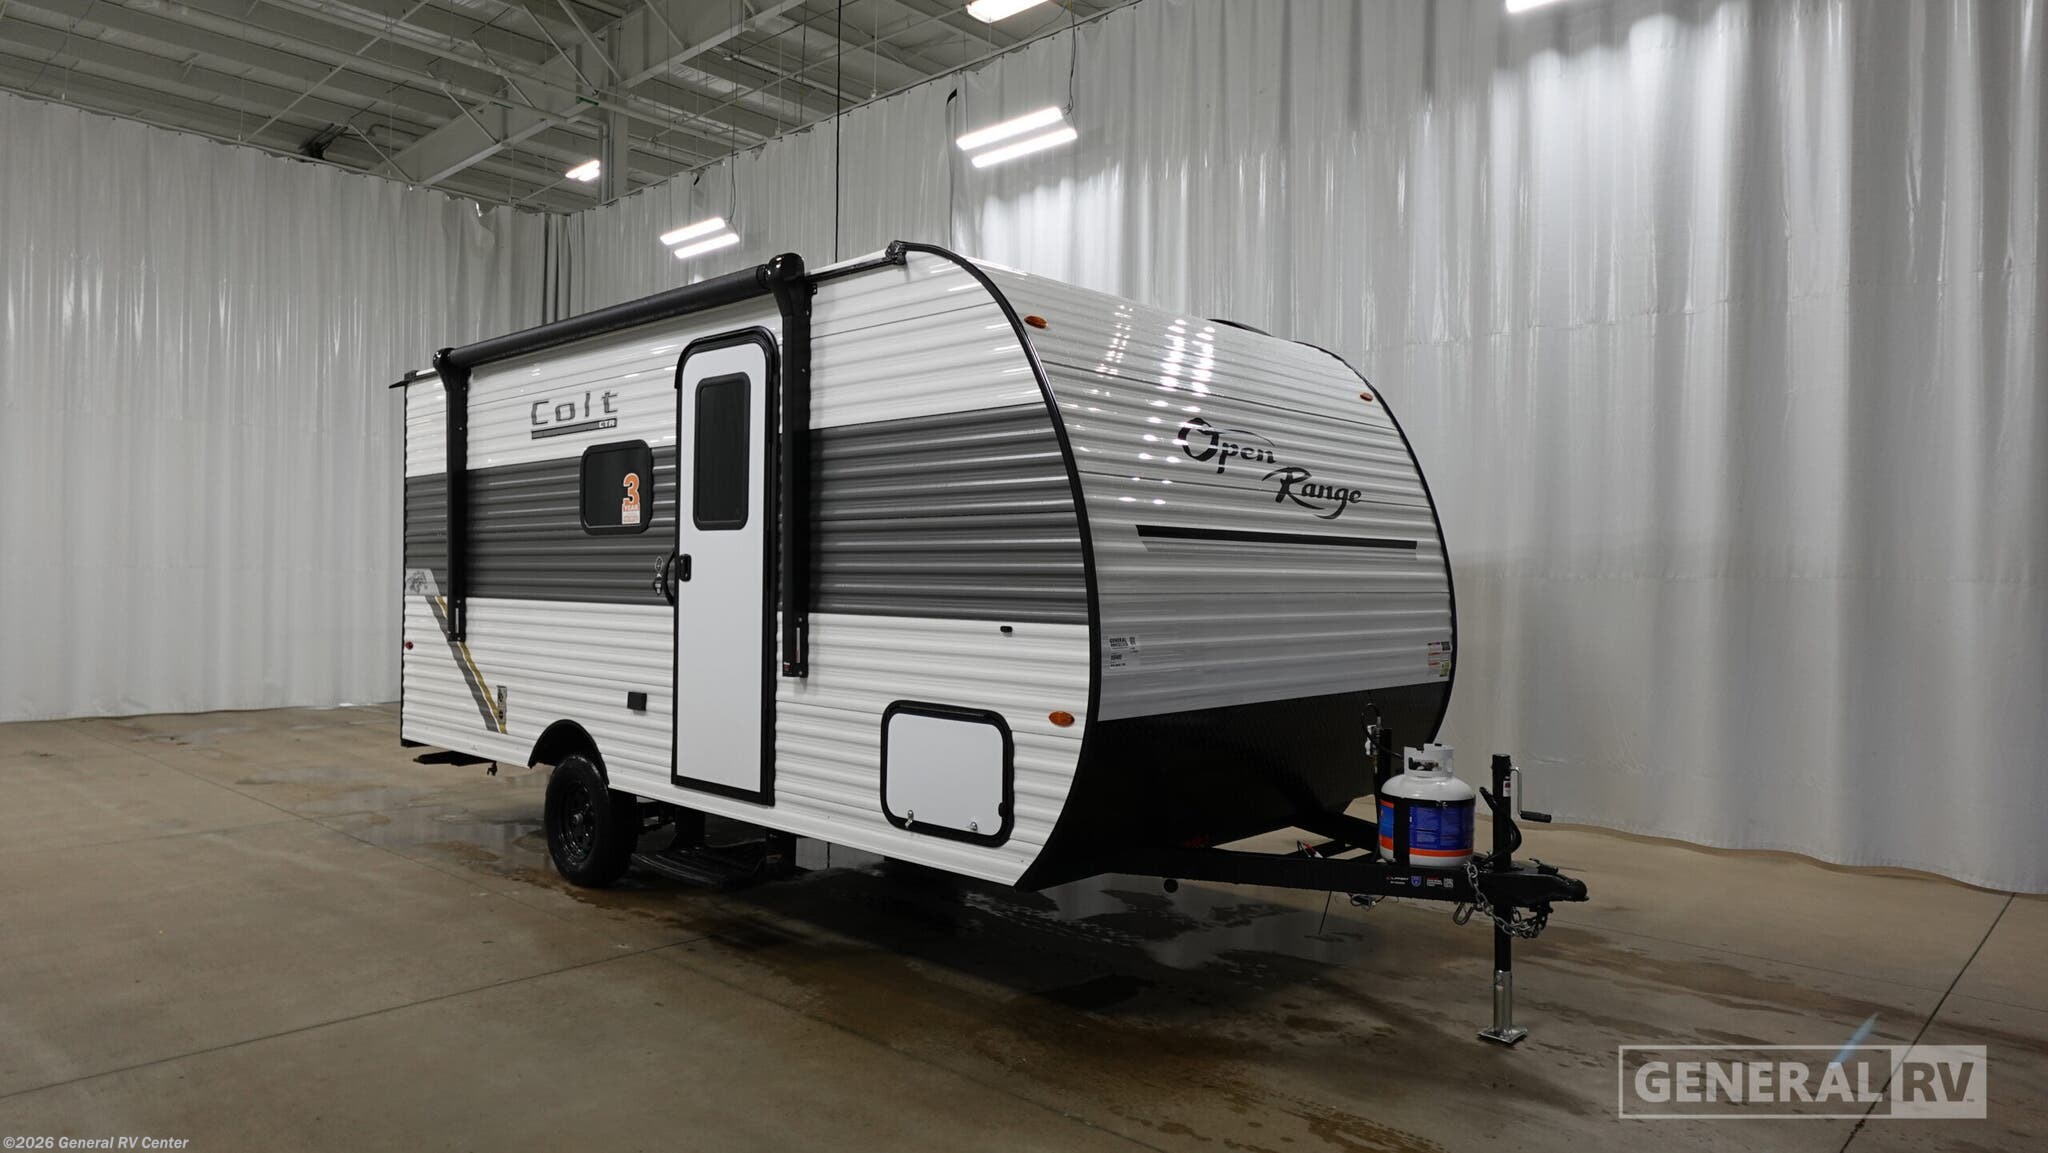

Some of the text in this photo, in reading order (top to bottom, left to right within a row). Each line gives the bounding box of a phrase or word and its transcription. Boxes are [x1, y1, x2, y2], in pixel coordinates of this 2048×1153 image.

[531, 391, 618, 425] Colt
[598, 419, 615, 428] CTR
[1178, 417, 1276, 474] Open
[623, 472, 640, 506] 3
[1262, 466, 1362, 520] Range
